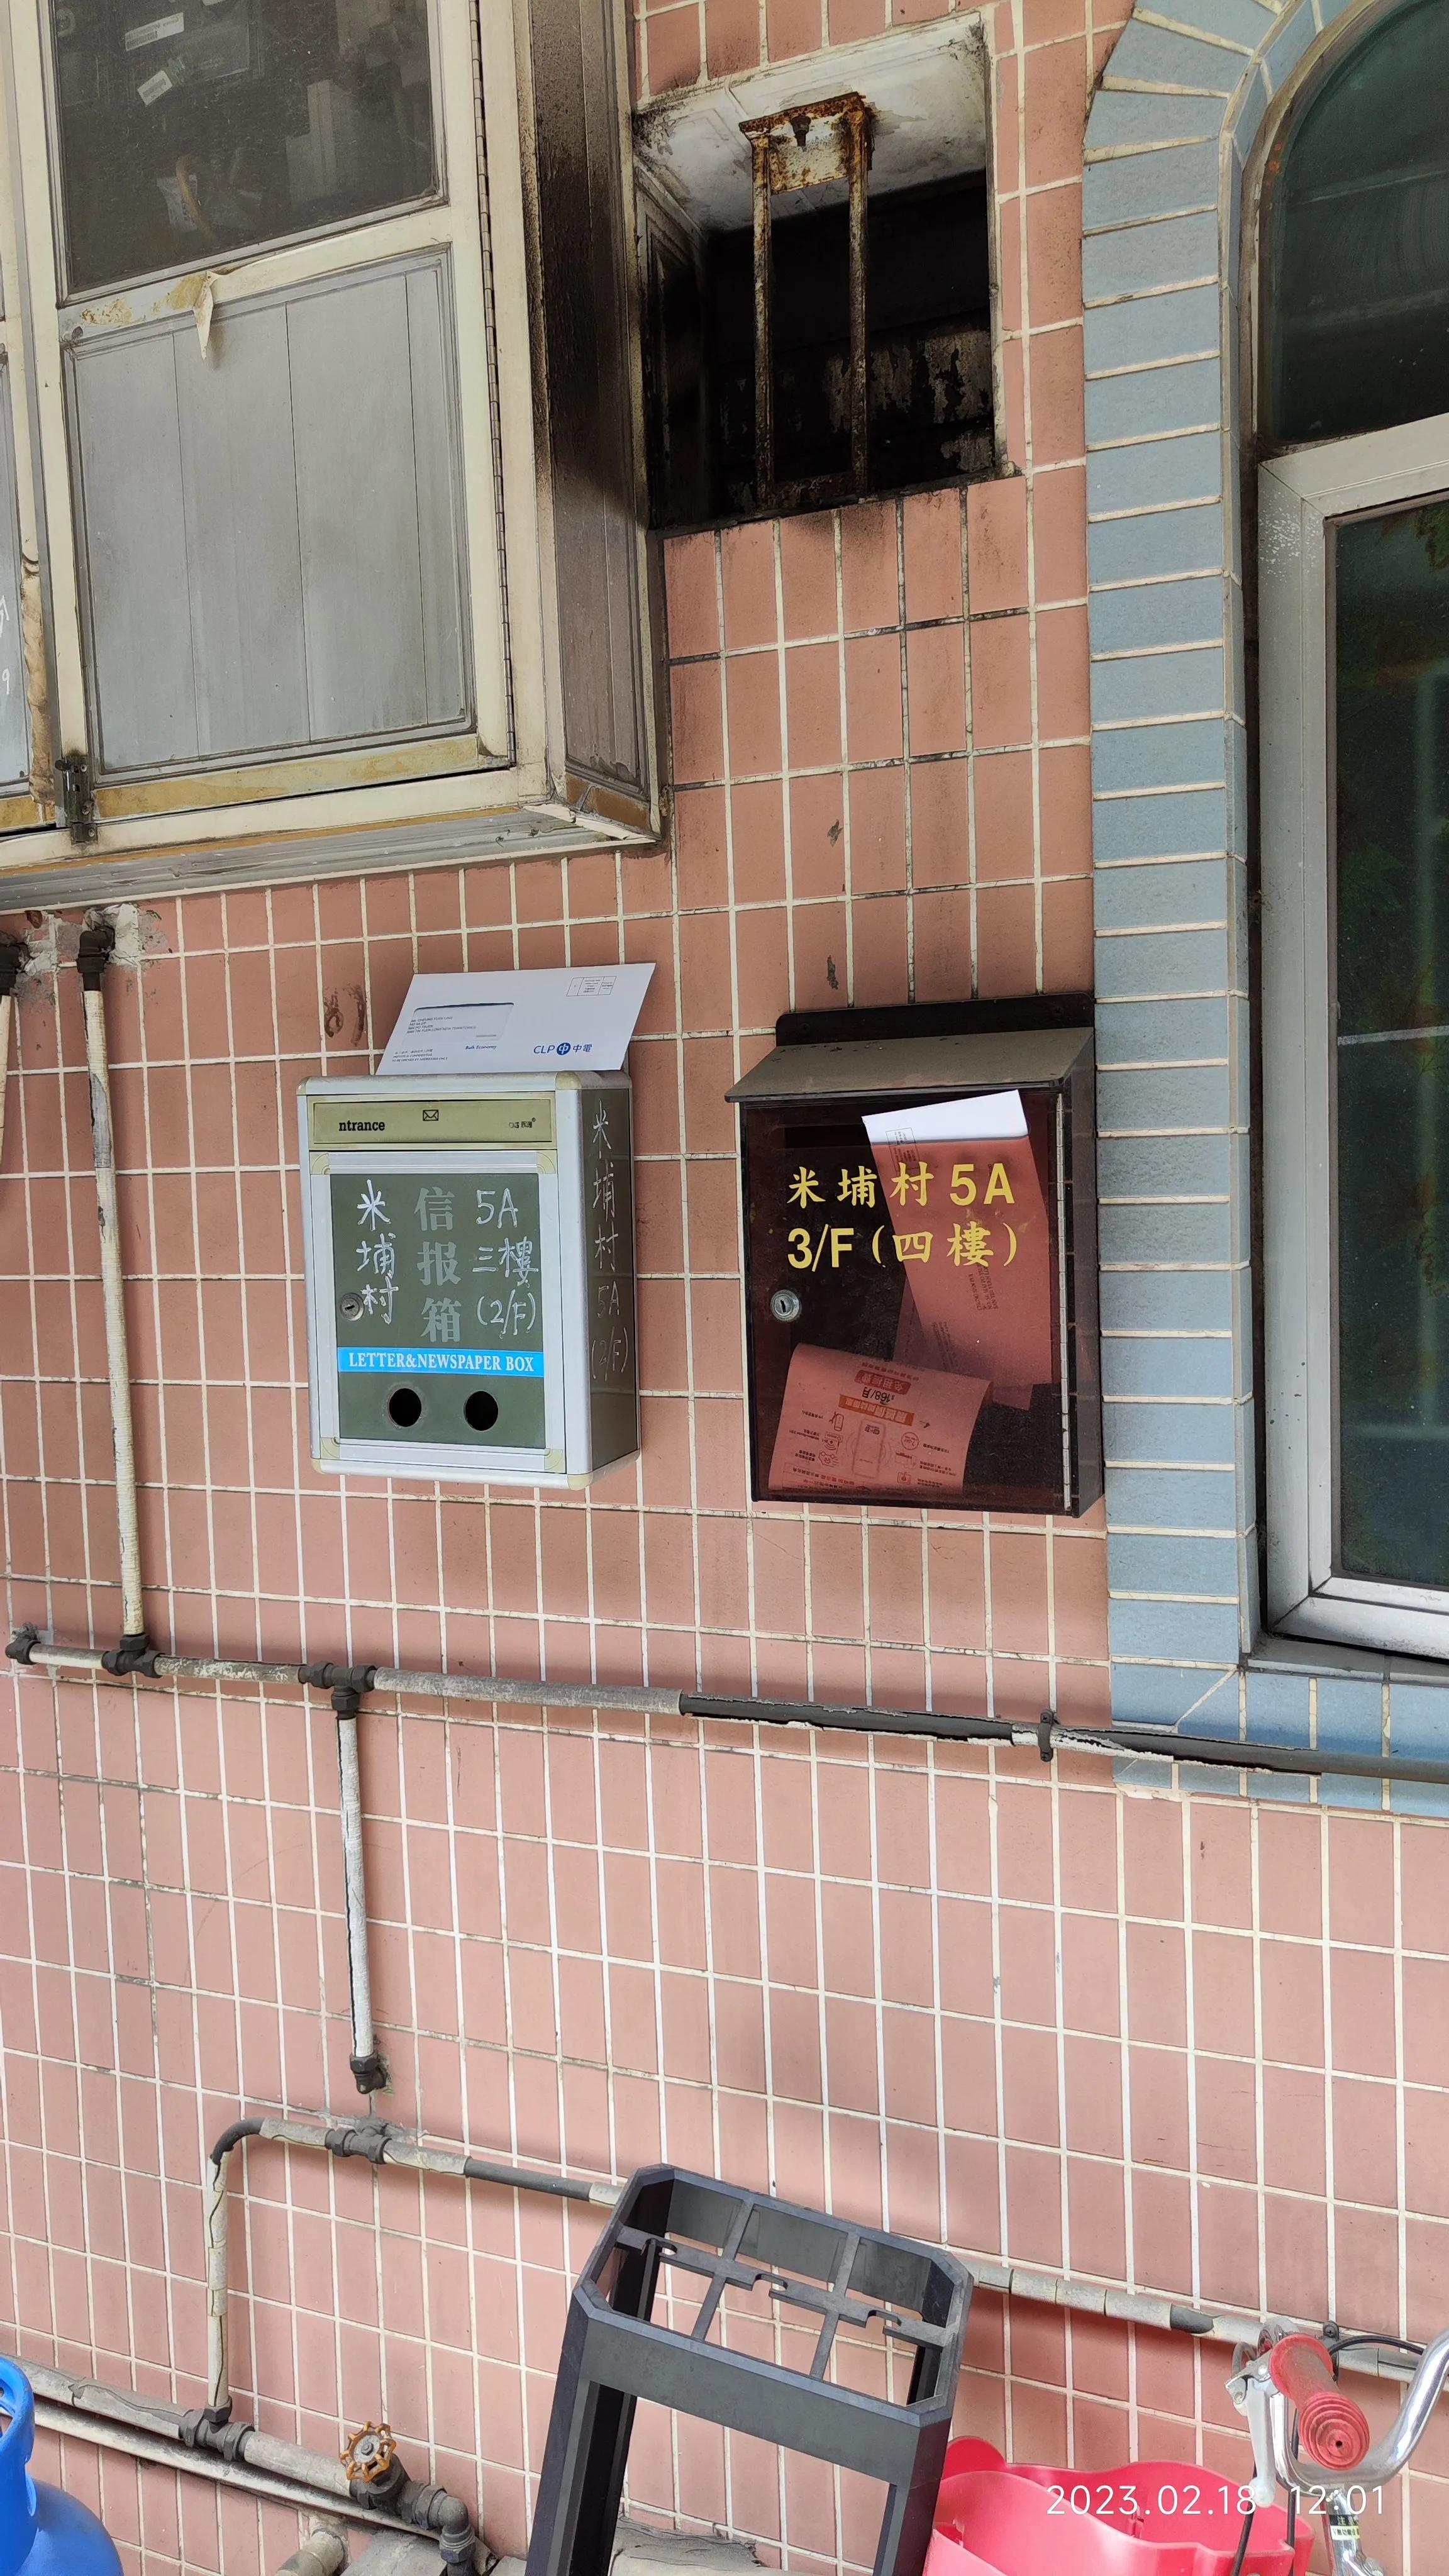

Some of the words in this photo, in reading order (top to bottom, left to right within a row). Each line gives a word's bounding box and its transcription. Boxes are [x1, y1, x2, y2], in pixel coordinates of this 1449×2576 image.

[533, 1045, 555, 1054] CLP
[475, 1187, 519, 1229] 5A
[414, 1186, 462, 1343] 信报箱
[348, 1352, 502, 1371] LETTER&NEWSPAPER
[506, 1356, 534, 1372] BOX
